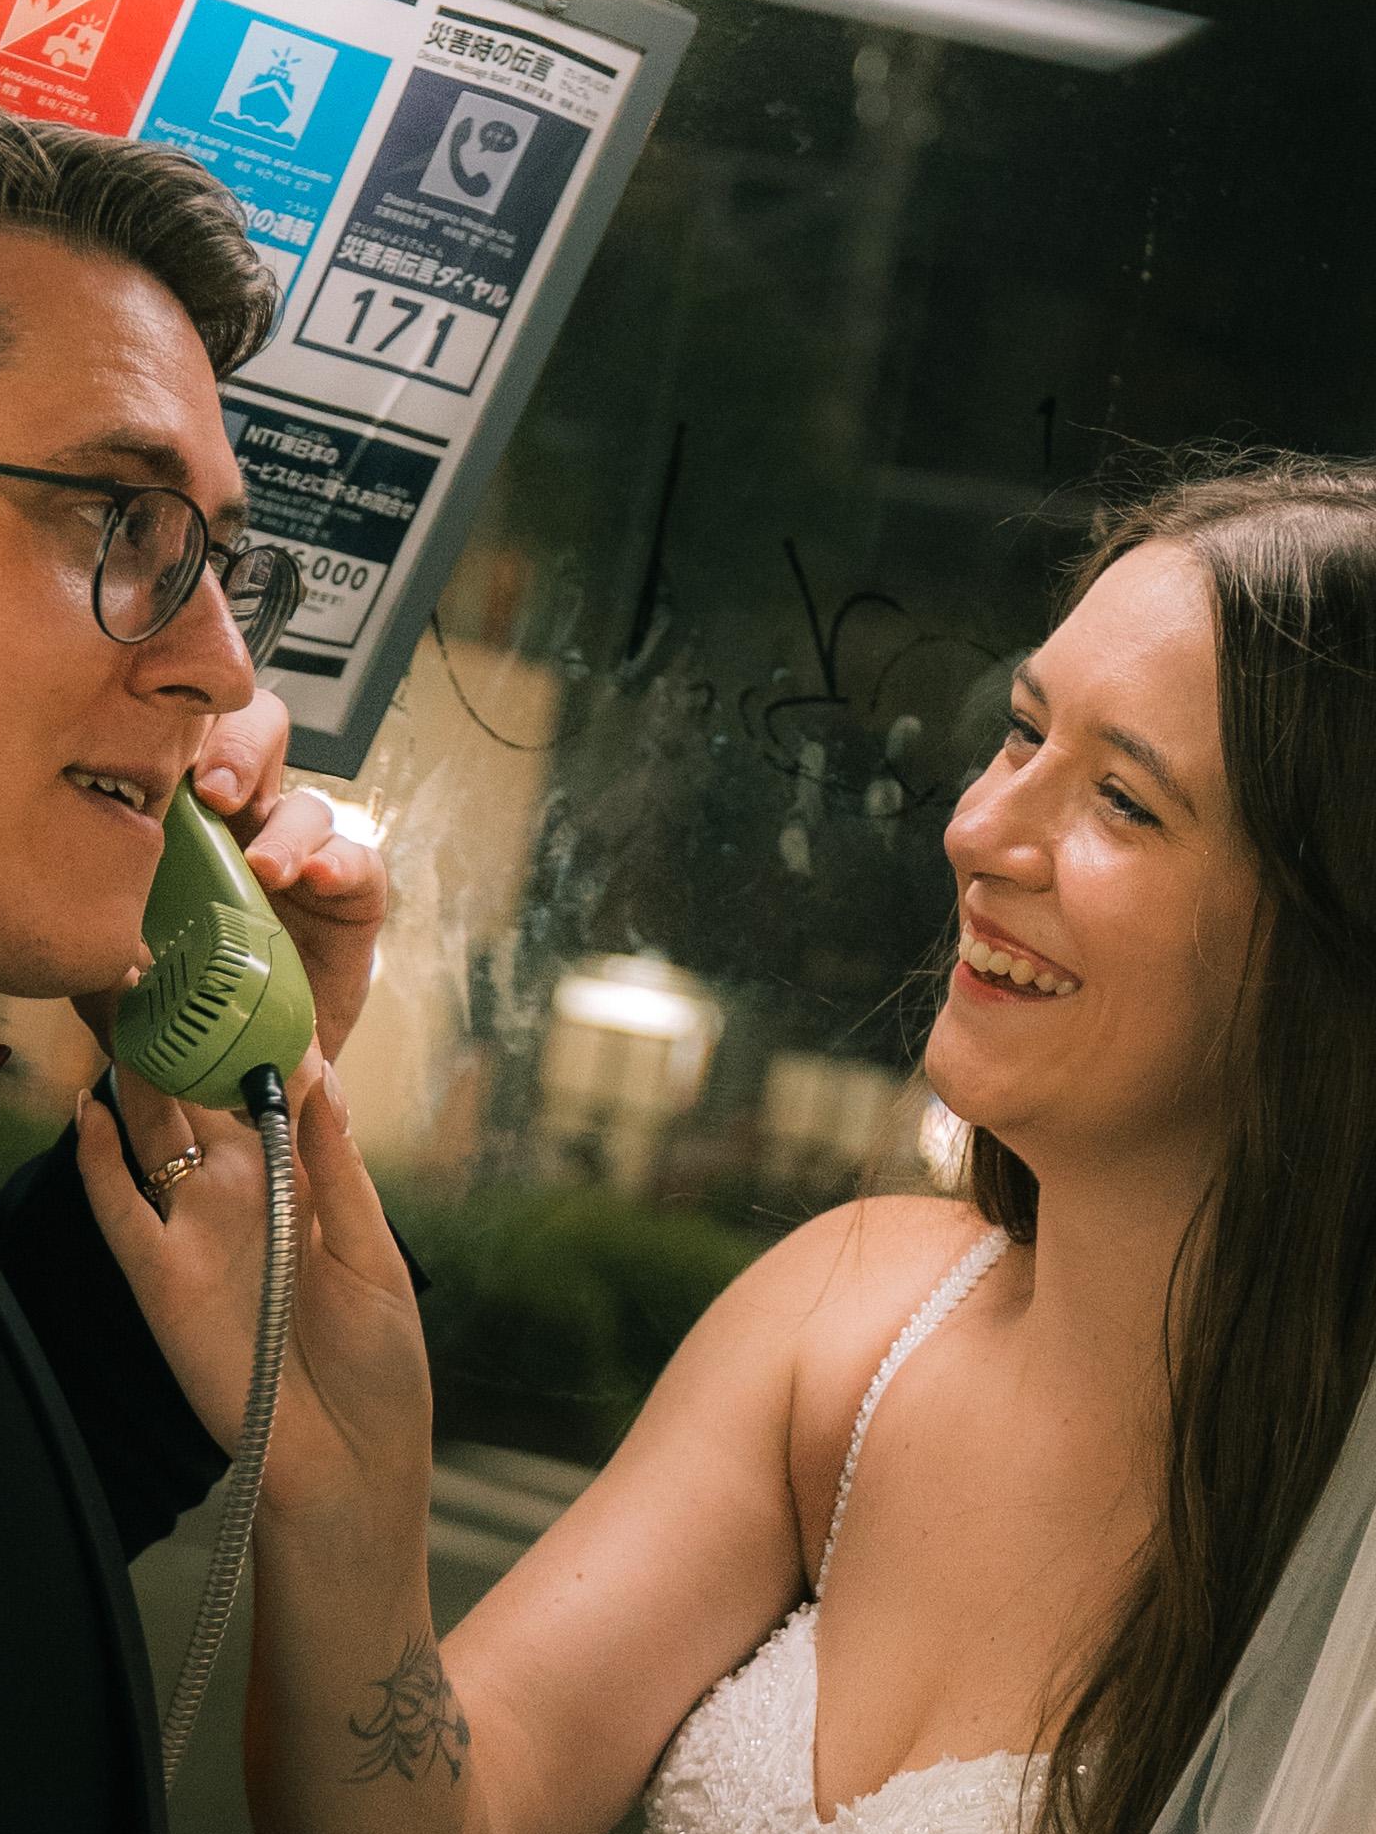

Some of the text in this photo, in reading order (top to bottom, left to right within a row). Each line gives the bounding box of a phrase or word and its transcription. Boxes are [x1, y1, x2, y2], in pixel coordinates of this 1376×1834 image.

[425, 21, 555, 82] 災害時の伝言
[337, 234, 511, 308] 災害用伝言ダイヤル
[346, 288, 457, 368] 171
